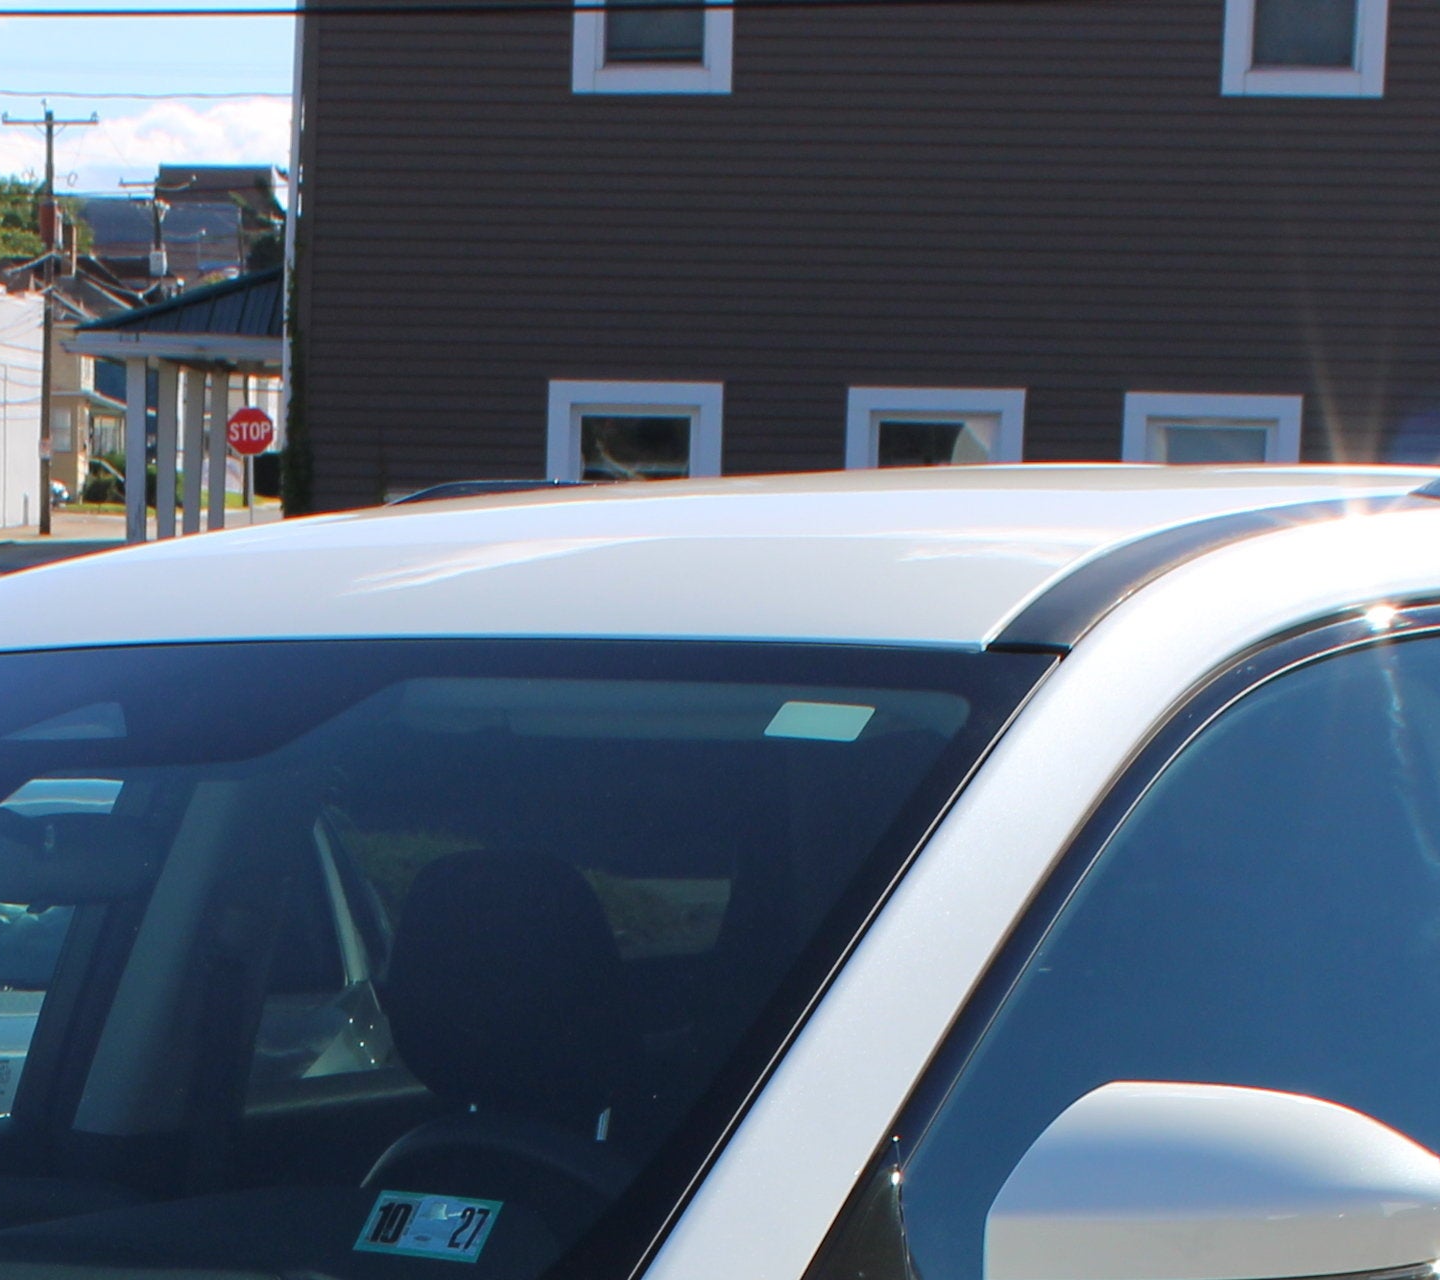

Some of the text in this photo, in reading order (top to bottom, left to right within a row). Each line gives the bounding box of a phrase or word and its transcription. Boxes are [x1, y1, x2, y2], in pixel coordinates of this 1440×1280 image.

[229, 423, 271, 442] STOP
[369, 1202, 491, 1250] 10 27
